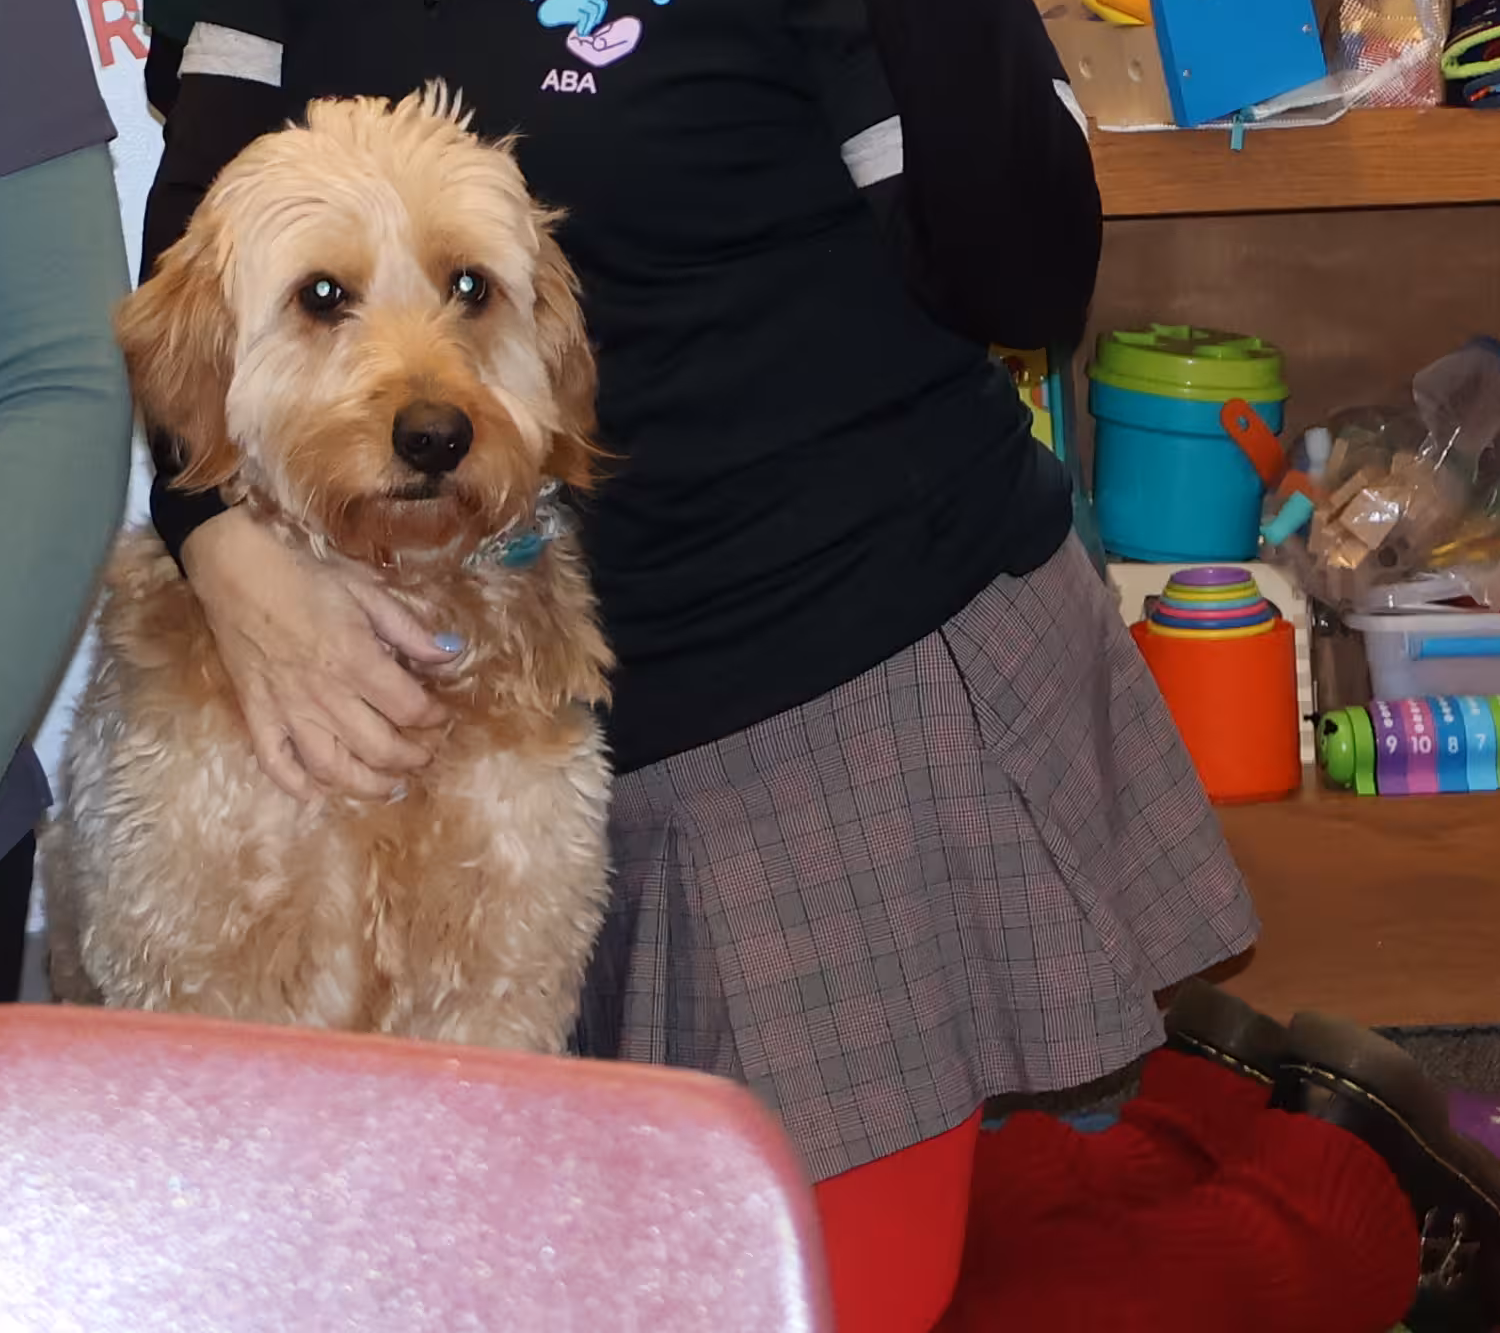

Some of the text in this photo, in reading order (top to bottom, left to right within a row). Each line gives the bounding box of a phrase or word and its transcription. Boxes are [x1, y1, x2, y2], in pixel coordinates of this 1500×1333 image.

[540, 69, 597, 94] ABA
[1386, 735, 1398, 754] 9
[1411, 735, 1432, 754] 10
[1448, 736, 1459, 754] 8
[1476, 734, 1487, 750] 7
